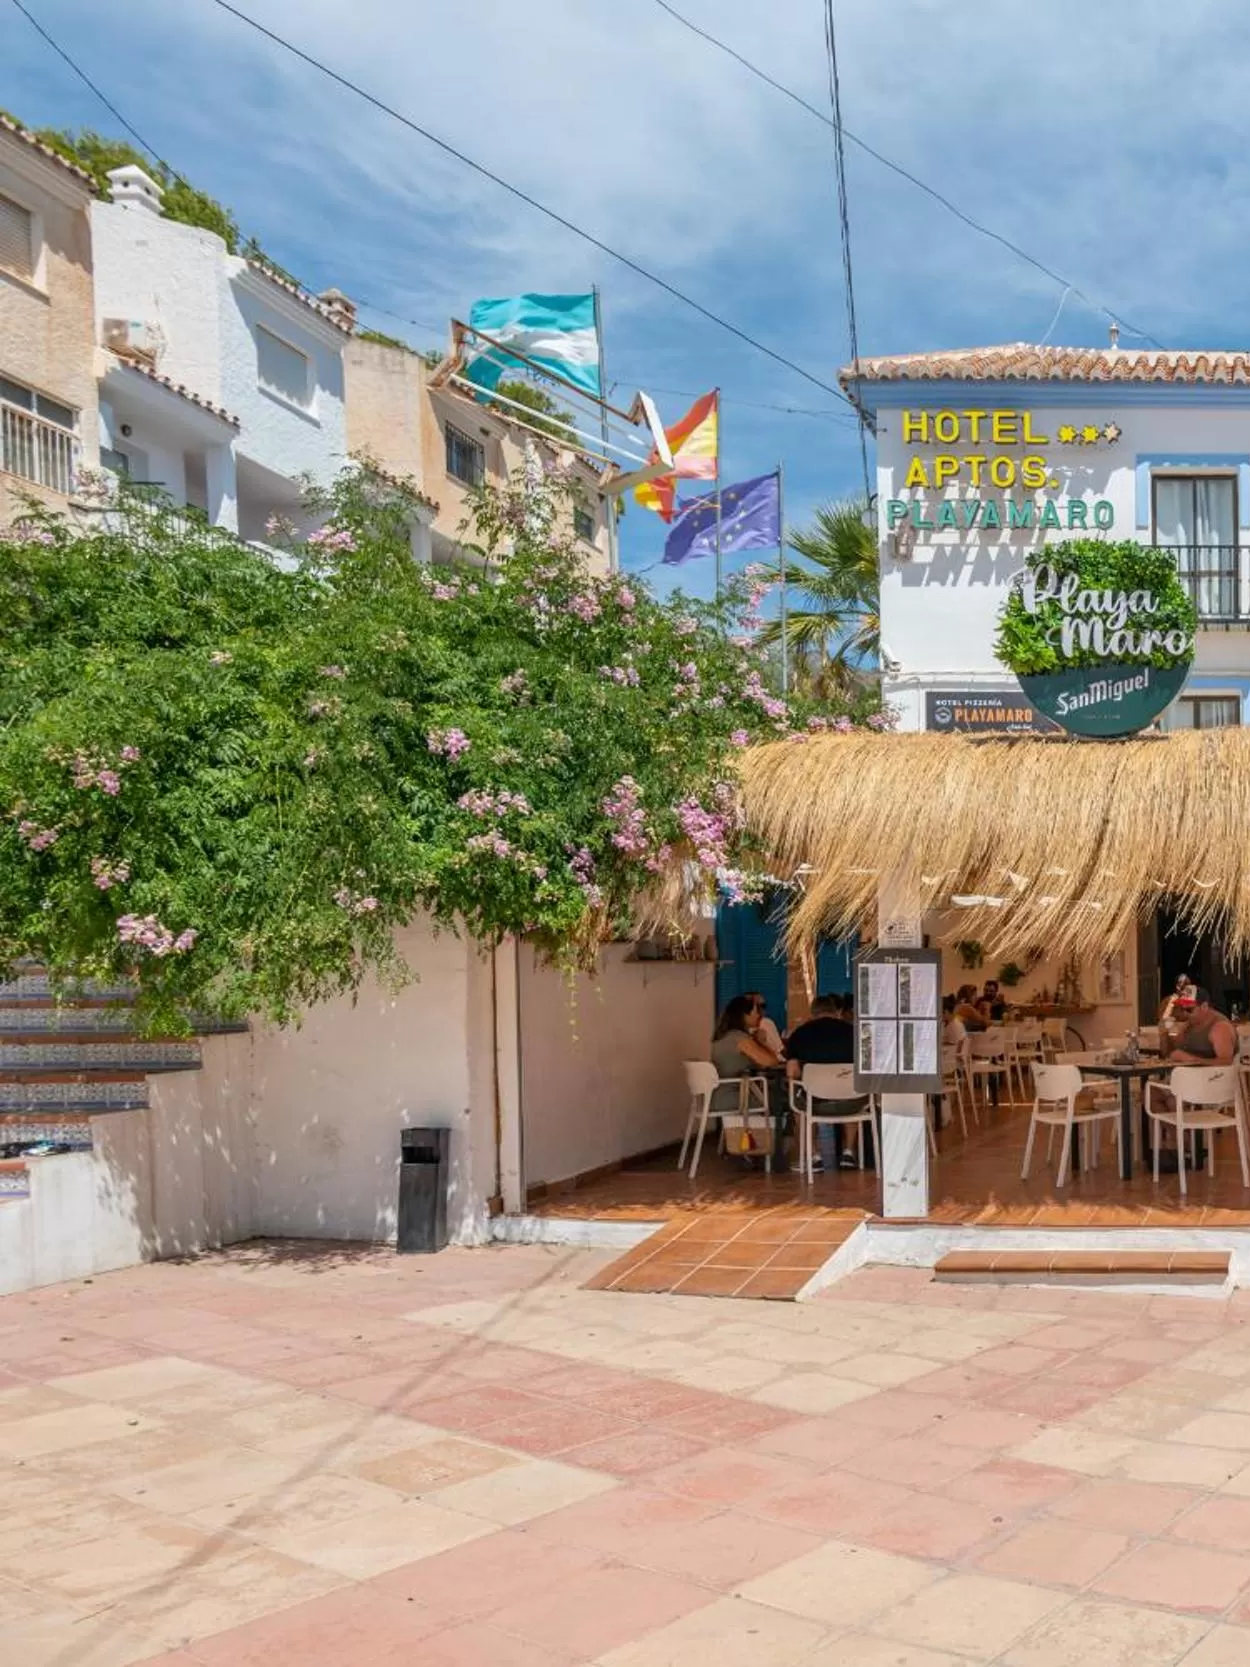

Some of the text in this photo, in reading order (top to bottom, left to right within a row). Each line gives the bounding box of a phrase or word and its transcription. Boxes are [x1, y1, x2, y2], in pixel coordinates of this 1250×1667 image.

[902, 408, 1049, 446] HOTEL
[886, 499, 1115, 531] PLAYAMARO
[1007, 563, 1161, 630] Playa
[1045, 615, 1195, 658] Maro
[953, 707, 1034, 723] PLAYAMARO
